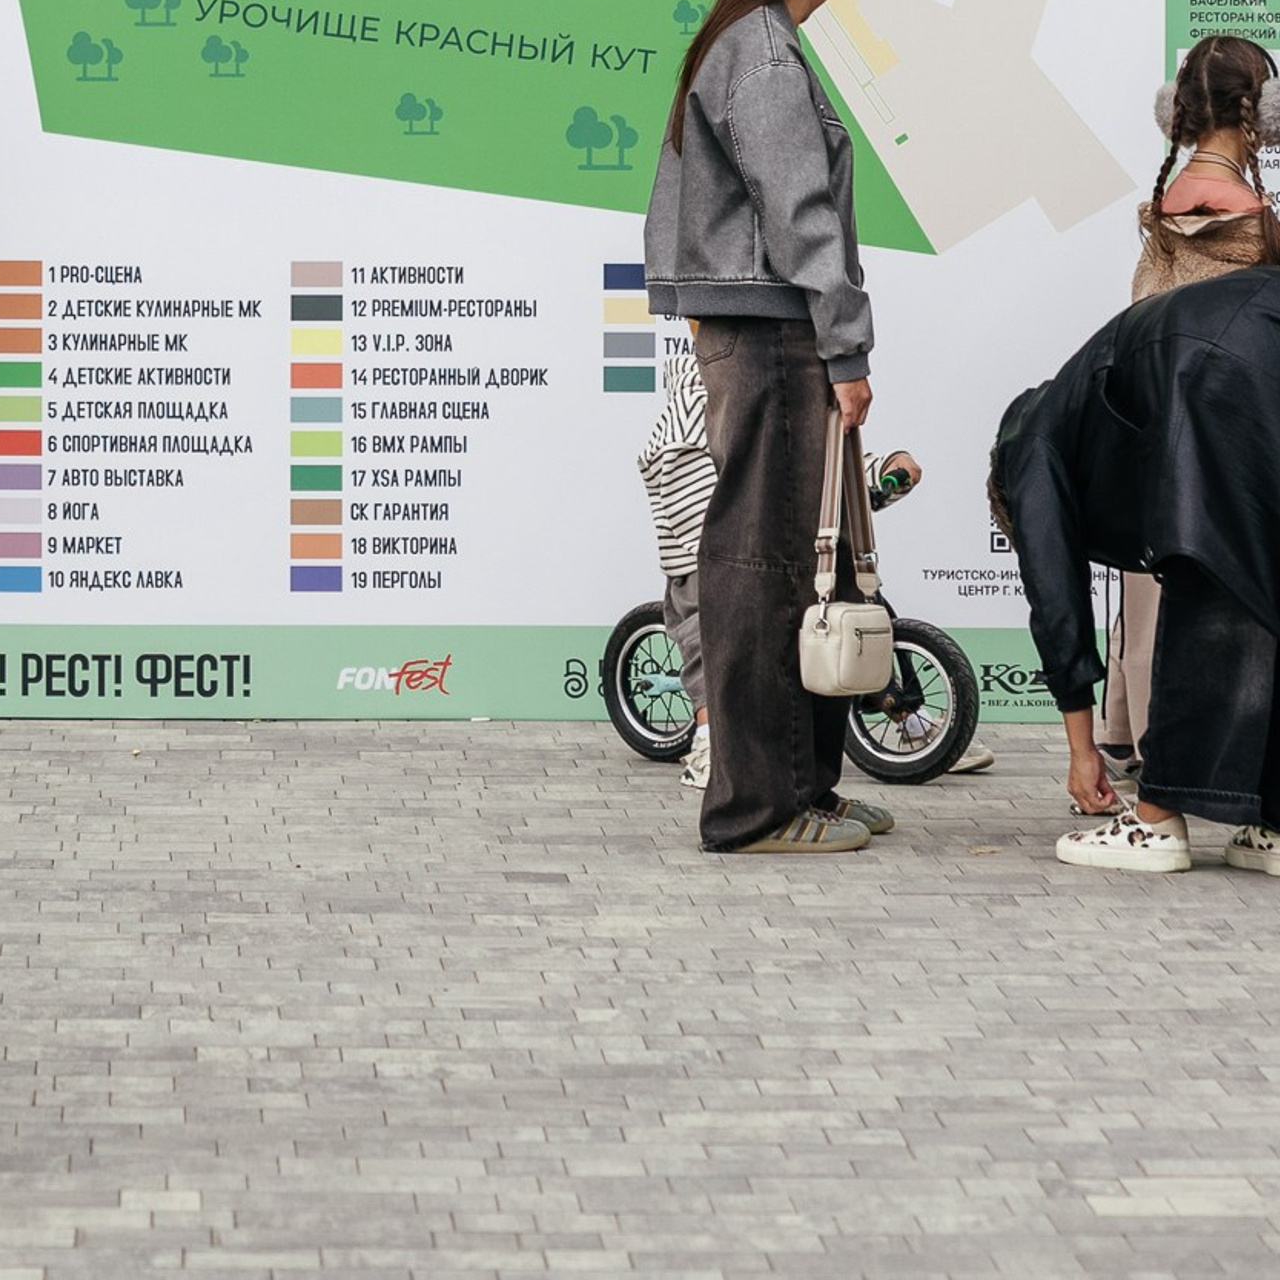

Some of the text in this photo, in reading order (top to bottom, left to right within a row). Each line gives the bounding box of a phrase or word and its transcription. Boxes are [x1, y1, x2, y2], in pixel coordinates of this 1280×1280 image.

[1190, 12, 1254, 23] РЕСТОРАН
[396, 19, 575, 65] КРАСНЫЙ
[591, 43, 657, 74] КУТ
[49, 265, 142, 285] 1 PRO-СЦЕНА
[351, 266, 463, 284] 11 АКТИВНОСТИ
[48, 299, 261, 320] 2 ДЕТСКИЕ КУЛИНАРНЫЕ МК
[351, 299, 536, 317] 12 PREMIUM-РЕСТОРАНЫ
[48, 333, 188, 351] 3 КУЛИНАРНЫЕ МК
[351, 334, 452, 352] 13 V.I.P. ЗОНА
[48, 367, 230, 388] 4 ДЕТСКИЕ АКТИВНОСТИ
[351, 367, 548, 389] 14 РЕСТОРАННЫЙ ДВОРИК
[48, 401, 228, 422] 5 ДЕТСКАЯ ПЛОЩАДКА
[351, 402, 489, 421] 15 ГЛАВНАЯ СЦЕНА
[48, 435, 252, 456] 6 СПОРТИВНАЯ ПЛОЩАДКА
[351, 435, 467, 453] 16 BMX РАМПЫ
[48, 469, 183, 487] 7 АВТО ВЫСТАВКА
[351, 469, 461, 487] 17 XSA РАМПЫ
[48, 502, 99, 520] 8 ЙОГА
[350, 503, 448, 521] СК ГАРАНТИЯ
[48, 537, 122, 554] 9 МАРКЕТ
[351, 537, 457, 554] 18 ВИКТОРИНА
[48, 570, 183, 591] 10 ЯНДЕКС ЛАВКА
[351, 571, 441, 588] 19 ПЕРГОЛЫ
[958, 585, 1000, 597] ЦЕНТР
[21, 653, 122, 697] РЕСТ!
[136, 654, 250, 697] ФЕСТ!
